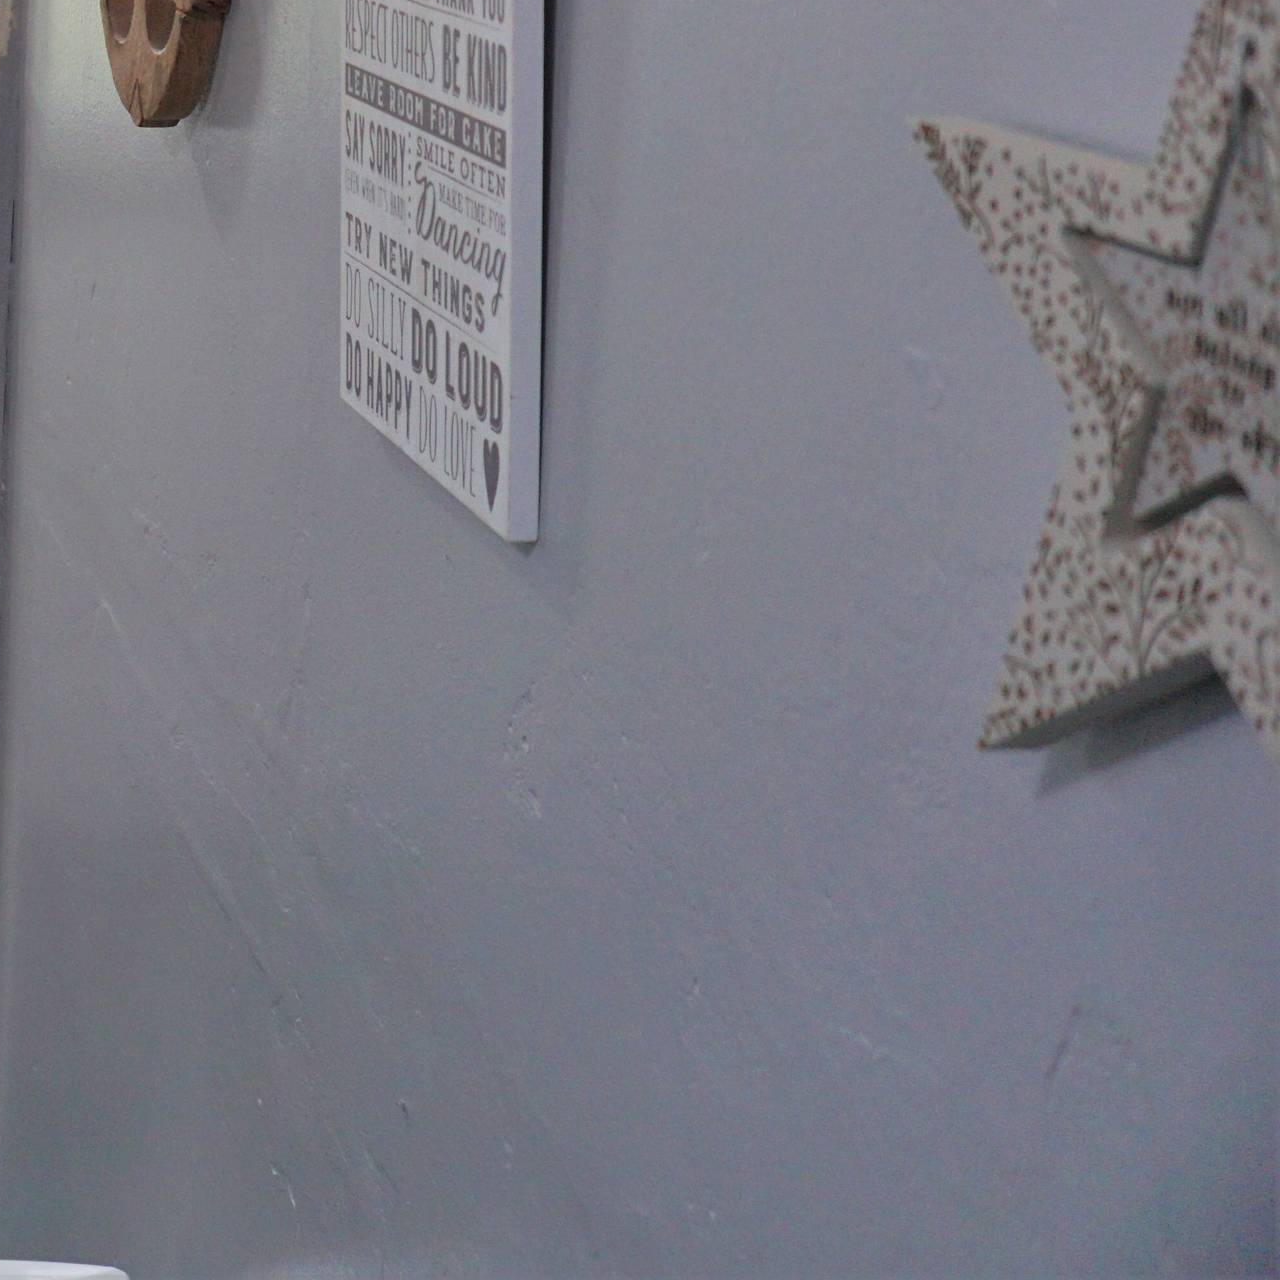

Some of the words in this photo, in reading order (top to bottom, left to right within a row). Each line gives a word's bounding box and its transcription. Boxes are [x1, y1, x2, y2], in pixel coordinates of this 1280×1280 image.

[346, 67, 384, 107] LEAVE
[389, 84, 424, 127] ROOM
[430, 101, 456, 142] FOR
[461, 116, 503, 162] CAKE
[391, 9, 436, 84] OTHERS
[442, 23, 462, 97] BE
[466, 32, 508, 115] KIND
[345, 109, 365, 167] SAY
[369, 120, 406, 188] SORRY
[416, 135, 455, 174] SMILE
[460, 156, 506, 199] OFTEN
[414, 160, 507, 317] Dancing
[438, 182, 464, 214] MAKE
[465, 195, 487, 226] TIME
[488, 208, 506, 236] FOR
[345, 211, 372, 259] TRY
[379, 231, 414, 286] NEW
[421, 256, 485, 333] THINGS
[345, 261, 362, 329] DO
[367, 277, 407, 361] SILLY
[411, 306, 438, 385] DO
[445, 329, 504, 435] LOUD
[345, 331, 362, 398] DO
[366, 347, 413, 441] HAPPY
[418, 385, 438, 463] DO
[443, 404, 477, 498] LOVE
